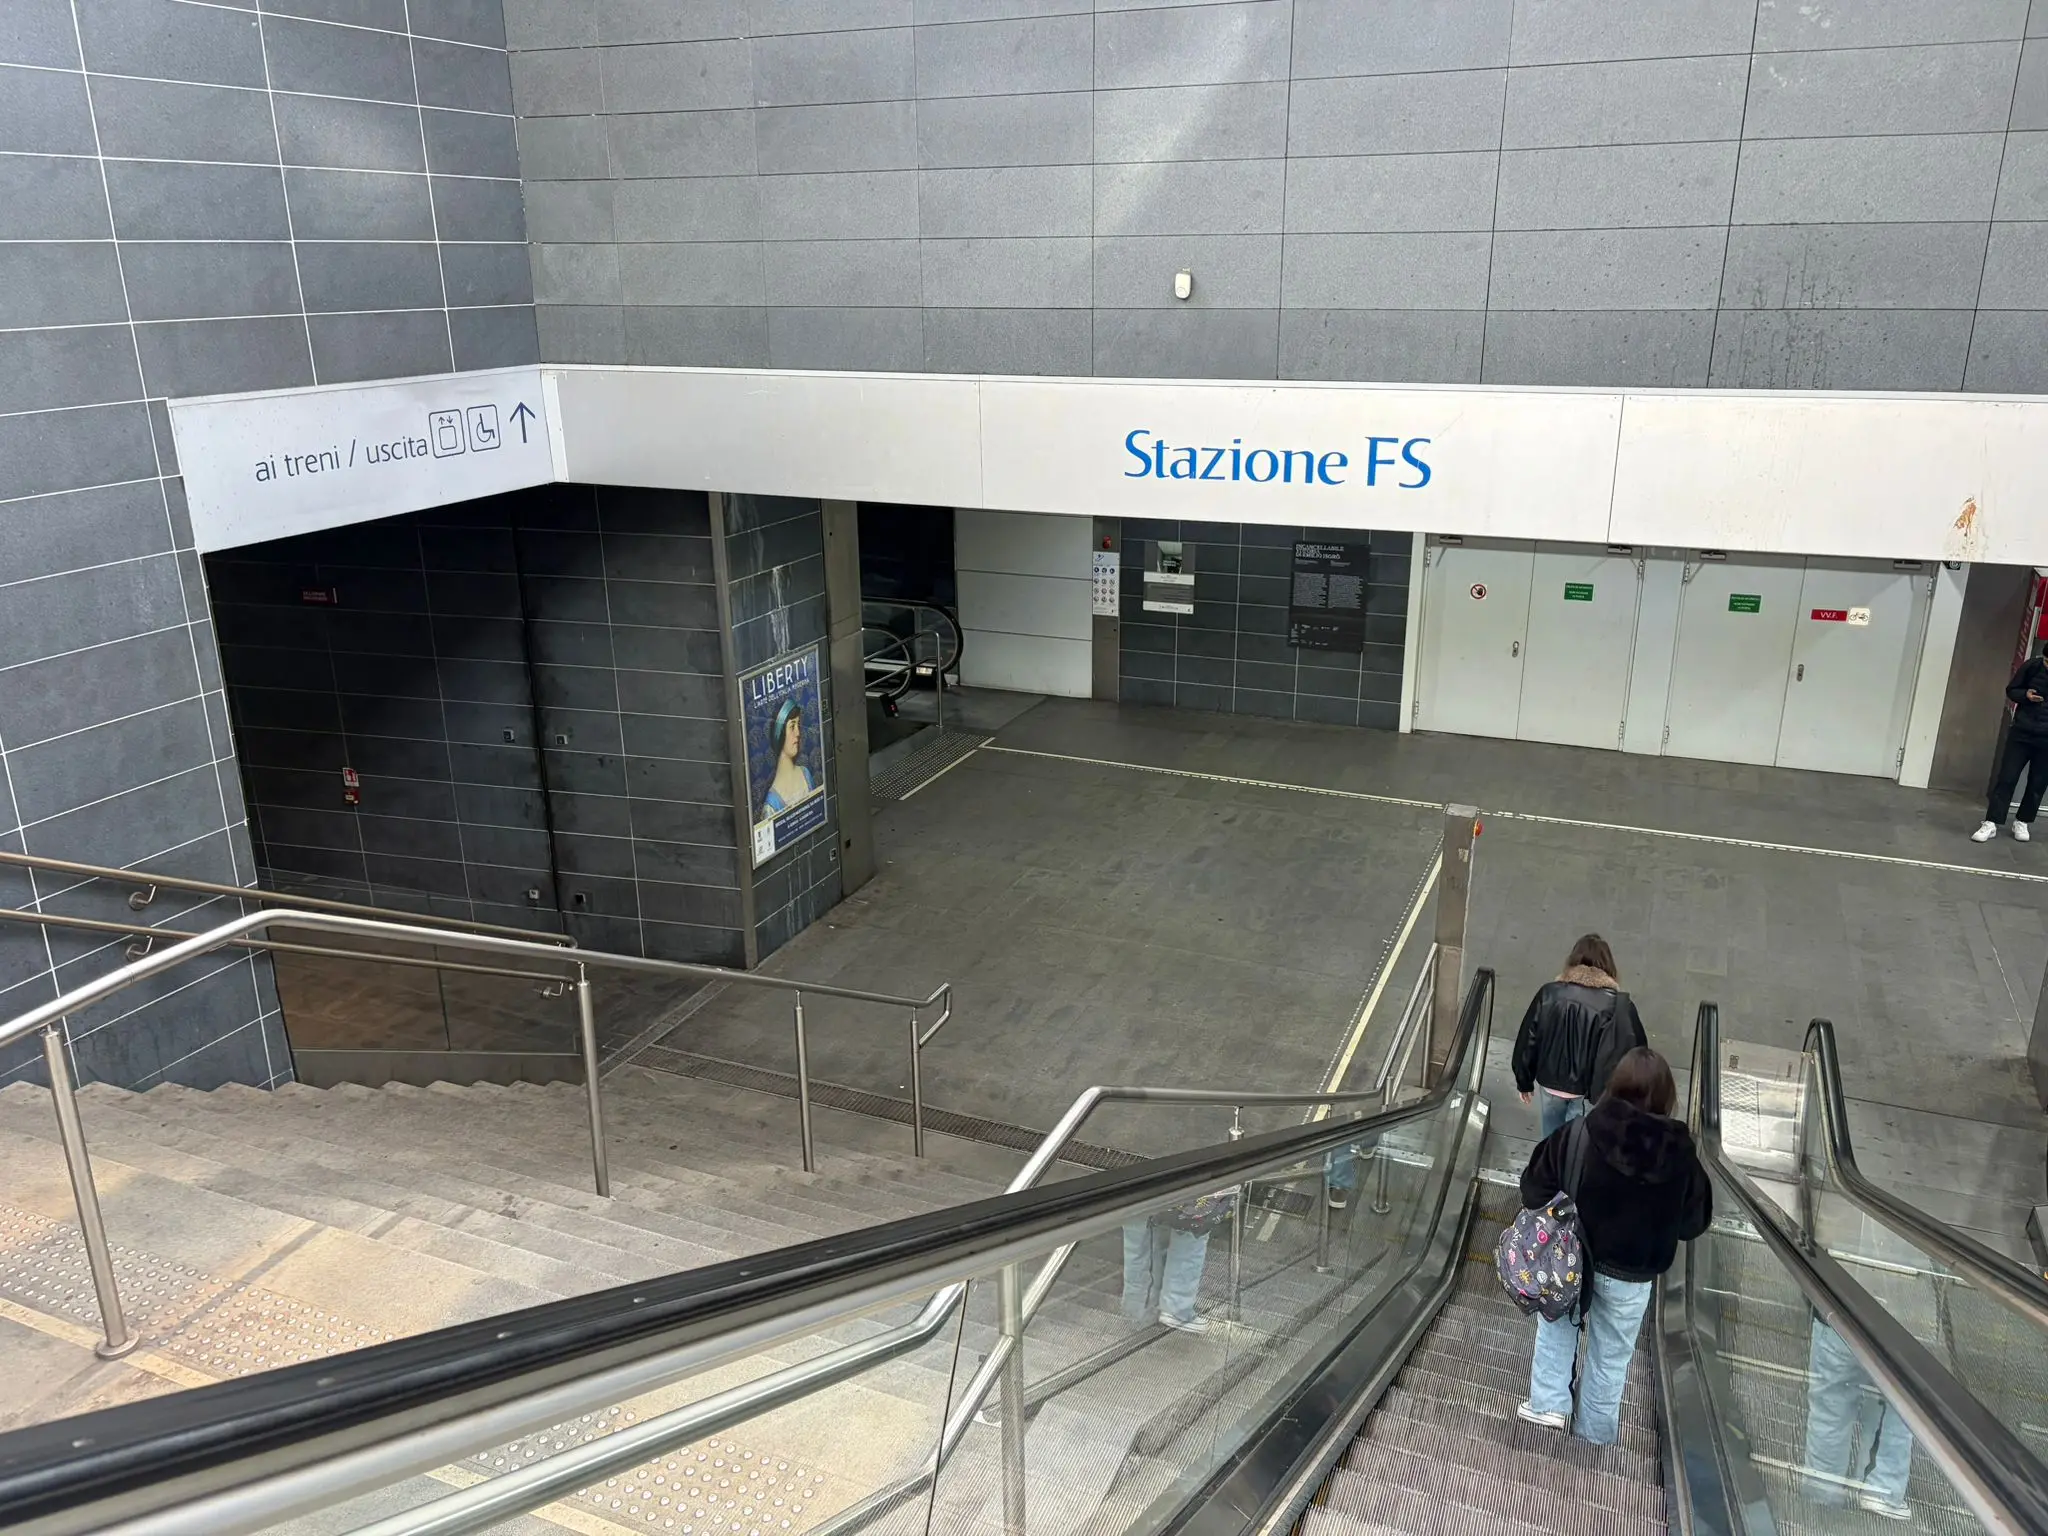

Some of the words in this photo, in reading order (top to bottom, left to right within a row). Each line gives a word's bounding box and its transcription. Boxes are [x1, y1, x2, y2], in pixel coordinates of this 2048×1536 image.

[255, 454, 277, 482] ai
[284, 445, 340, 477] treni
[349, 439, 356, 467] /
[366, 436, 428, 464] uscita
[1124, 429, 1348, 486] Stazione
[1365, 436, 1432, 489] FS
[752, 656, 808, 700] LIBERTY
